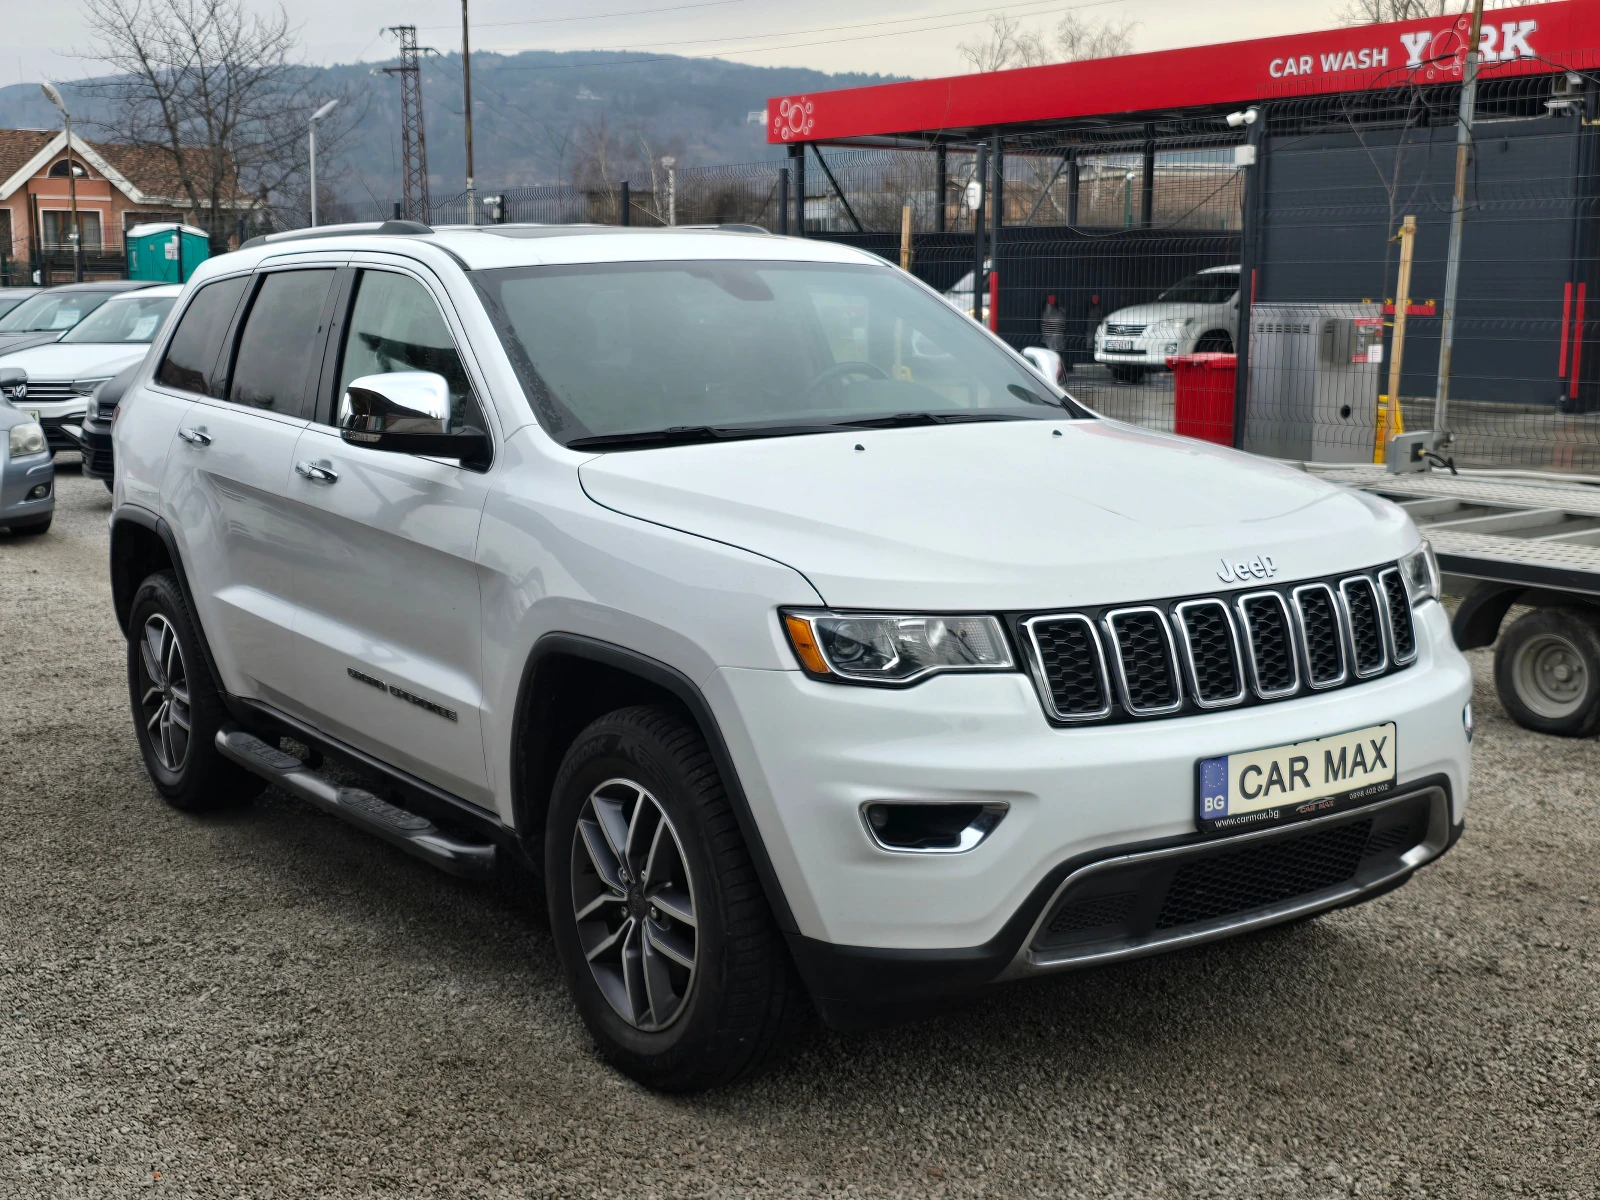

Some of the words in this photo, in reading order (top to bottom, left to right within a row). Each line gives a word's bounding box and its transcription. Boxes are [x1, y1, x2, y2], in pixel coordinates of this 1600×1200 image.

[1400, 19, 1538, 71] YORK
[1269, 55, 1314, 79] CAR
[1319, 46, 1389, 73] WASH
[1216, 555, 1277, 584] Jeep
[1238, 755, 1311, 801] CAR
[1323, 735, 1388, 784] MAX
[1204, 795, 1224, 812] BG
[1214, 809, 1279, 828] www.carmax.bg
